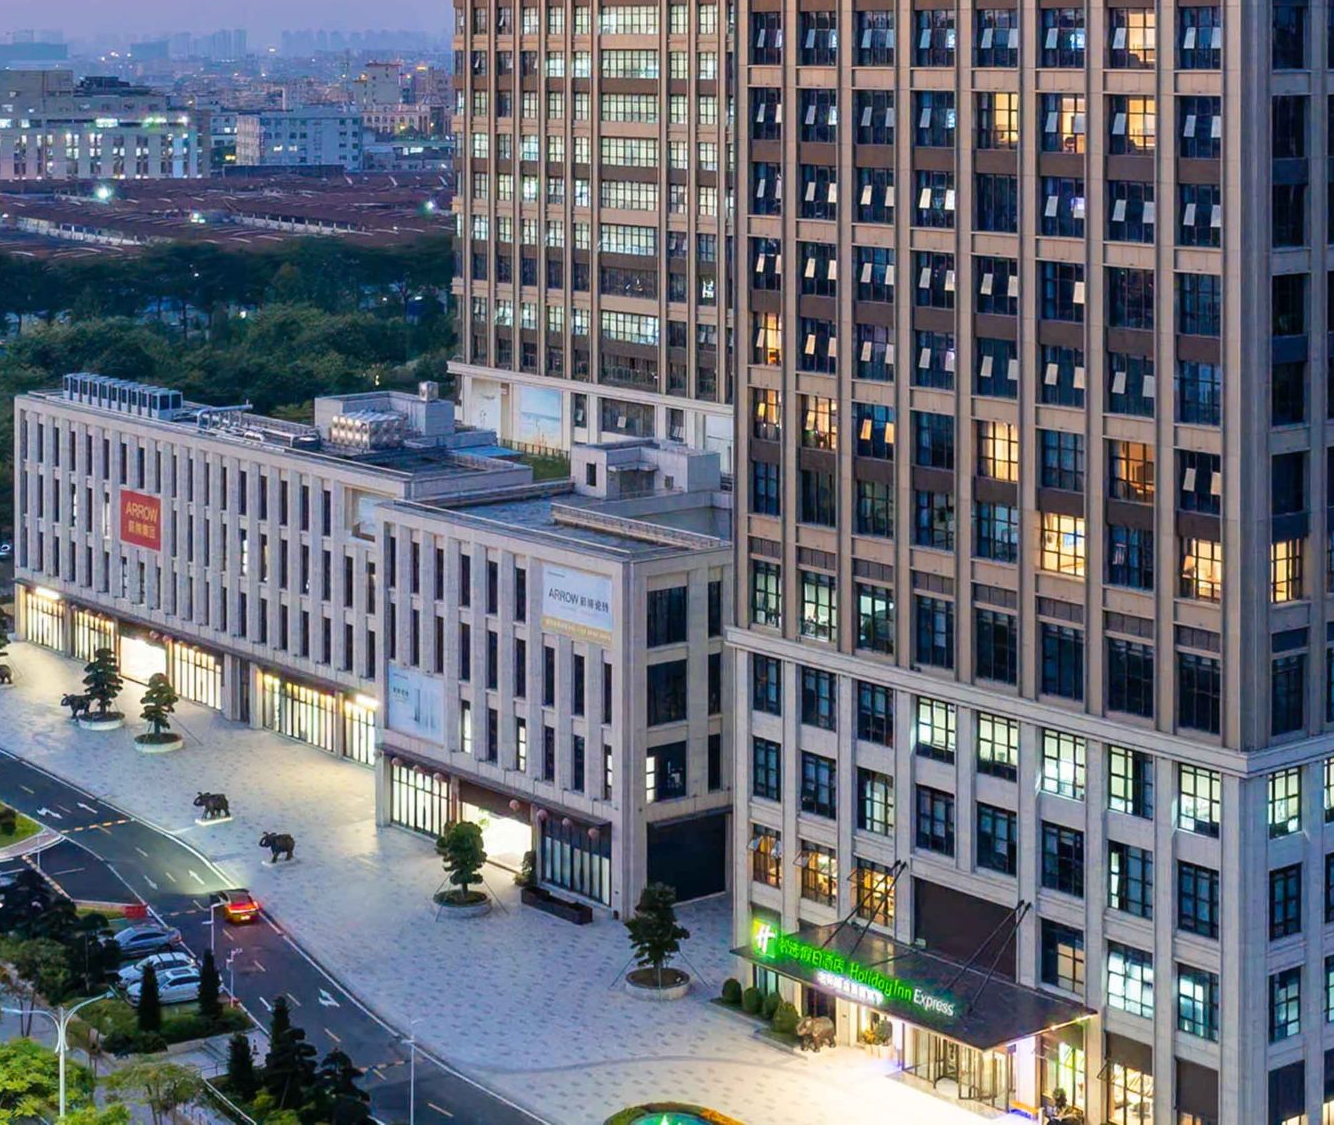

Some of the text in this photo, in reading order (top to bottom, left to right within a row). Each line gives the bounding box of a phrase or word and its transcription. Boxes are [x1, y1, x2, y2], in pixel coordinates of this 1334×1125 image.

[125, 501, 158, 523] ARROW
[548, 586, 579, 605] ARROW
[849, 962, 892, 997] Holiday
[893, 978, 913, 1001] Inn
[913, 988, 955, 1016] Express
